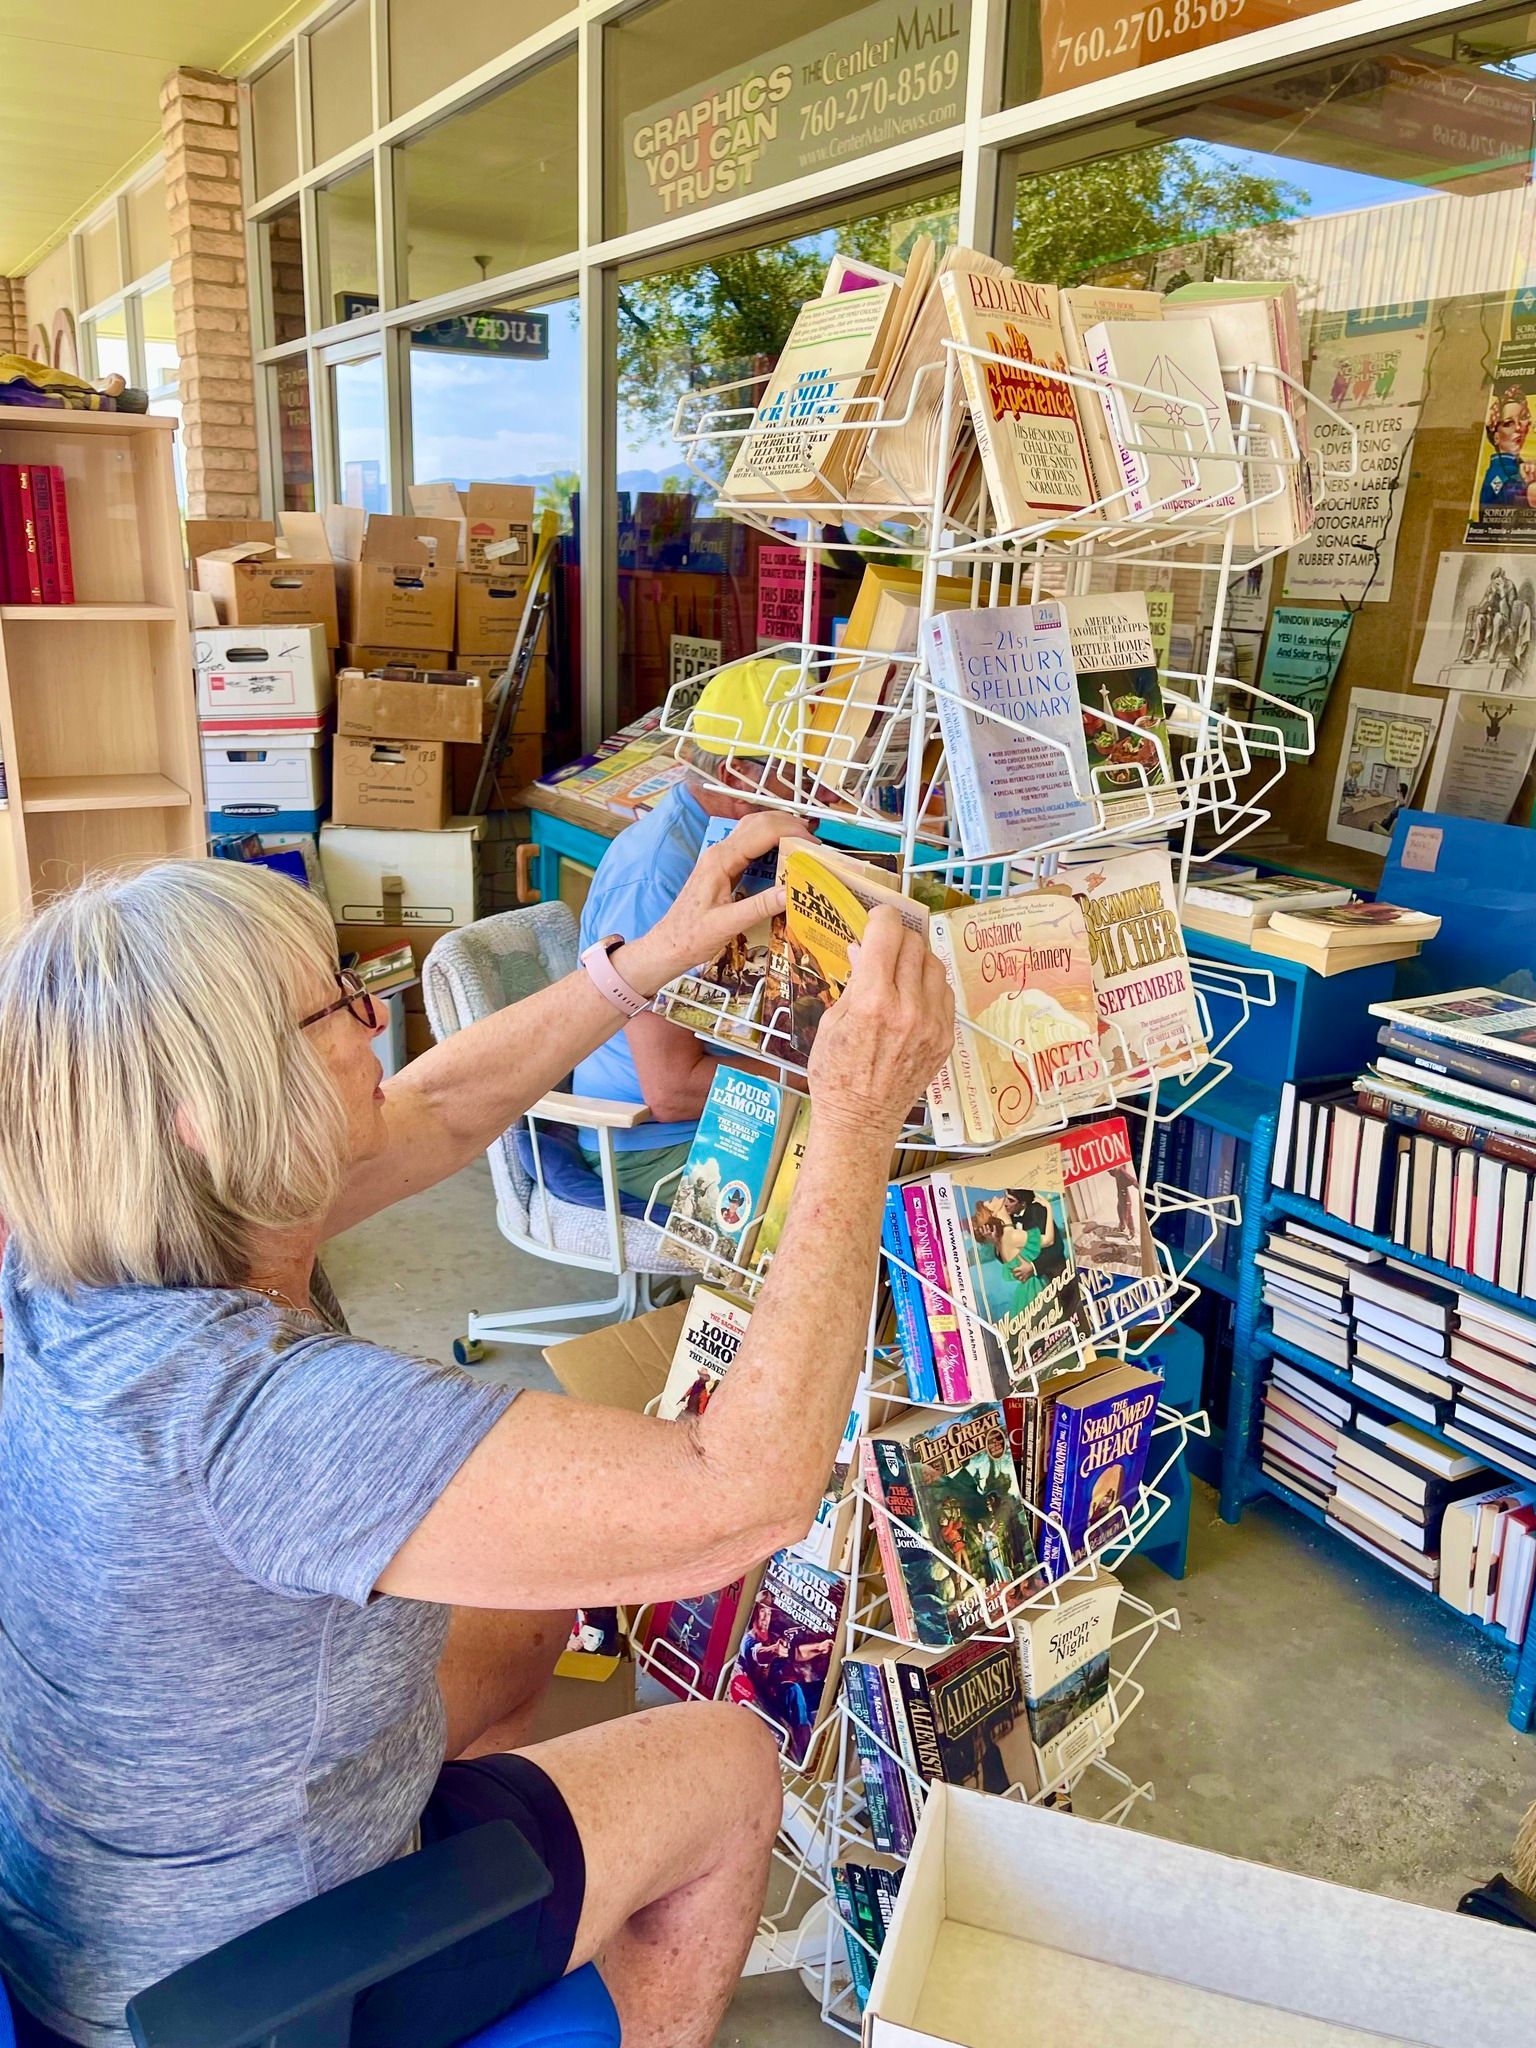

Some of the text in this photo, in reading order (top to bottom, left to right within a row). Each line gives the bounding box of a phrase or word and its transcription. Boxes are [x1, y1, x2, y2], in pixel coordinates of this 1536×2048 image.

[800, 49, 960, 142] 760-270-8569
[633, 64, 793, 159] GRAPHICS
[644, 107, 778, 186] YOU CAN
[658, 149, 759, 213] TRUST
[775, 383, 839, 405] FMILY
[981, 363, 1075, 419] Experience
[1013, 423, 1074, 444] HIS RENOWNED
[1363, 418, 1403, 434] FLYERS
[1019, 452, 1078, 470] TO THE SANITY
[1023, 440, 1071, 456] CHALLENGE
[1030, 467, 1041, 480] OF
[1361, 457, 1398, 472] CARDS
[1065, 483, 1082, 496] MAN
[1315, 496, 1379, 511] BROCHURES
[1311, 515, 1388, 530] HOTOGRAPHY
[1316, 535, 1367, 548] SIGNAGE
[1298, 553, 1334, 566] RUBBER
[761, 587, 816, 605] THIS LIBRY
[762, 604, 798, 621] BELONGS
[1084, 615, 1128, 625] AMERICA'S
[1279, 615, 1311, 625] WINDOW
[1112, 622, 1149, 634] RECIPES
[1298, 636, 1308, 644] do
[673, 642, 718, 660] GIVE or TAKE
[1072, 638, 1151, 656] BETTER HOMES
[1078, 652, 1149, 669] AND GARDENS
[1277, 648, 1311, 659] And Solar
[968, 649, 1064, 677] CENTURY
[971, 672, 1071, 700] SPELLING
[974, 695, 1071, 725] DICTIONARY
[1027, 761, 1054, 770] DICTIONARY
[793, 903, 813, 919] THE
[964, 921, 1022, 952] Constance
[1088, 910, 1184, 979] PILCHER
[1098, 969, 1185, 1017] SEPTEMBER
[725, 1077, 771, 1106] LOUIS
[941, 1065, 951, 1091] TOXIC
[711, 1088, 776, 1125] L'AMOUR
[718, 1117, 731, 1126] THE
[732, 1121, 750, 1135] TRAIL
[751, 1130, 759, 1138] TO
[719, 1124, 755, 1144] CRAZY MAN
[889, 1212, 903, 1248] ROBERT
[914, 1217, 946, 1315] CONNIE BROWAY
[945, 1218, 980, 1361] WAYWARD ANGEL Arkham
[995, 1260, 1076, 1346] Wayward
[710, 1313, 721, 1323] THE
[686, 1328, 736, 1364] L'AMO
[700, 1320, 741, 1352] LOUI
[689, 1350, 727, 1376] THE LONEL
[1081, 1394, 1154, 1445] SHADOWED
[1111, 1398, 1129, 1413] THE
[914, 1411, 1000, 1463] THE GREAT
[1080, 1422, 1142, 1478] HEART
[945, 1434, 986, 1475] HUNT
[1053, 1440, 1067, 1482] SHADOWED
[887, 1496, 914, 1507] GREAT
[889, 1486, 909, 1496] THE
[1050, 1482, 1064, 1510] HEART
[890, 1506, 916, 1516] HUNT
[781, 1551, 830, 1597] LOUIS
[768, 1559, 837, 1620] L'AMOUR
[956, 1578, 1002, 1616] Roert
[764, 1579, 834, 1634] THE OUTLAWS OF
[774, 1597, 820, 1633] MESQUITE
[959, 1596, 1002, 1631] Joran
[1049, 1614, 1100, 1653] Simon's
[1055, 1632, 1090, 1664] Night
[1065, 1648, 1096, 1672] NOVEL
[1022, 1636, 1032, 1695] Simon's Night
[948, 1657, 1011, 1730] ALIENIST
[873, 1695, 885, 1725] MASKS
[954, 1711, 980, 1733] CALEB
[910, 1701, 943, 1776] ALIENIST
